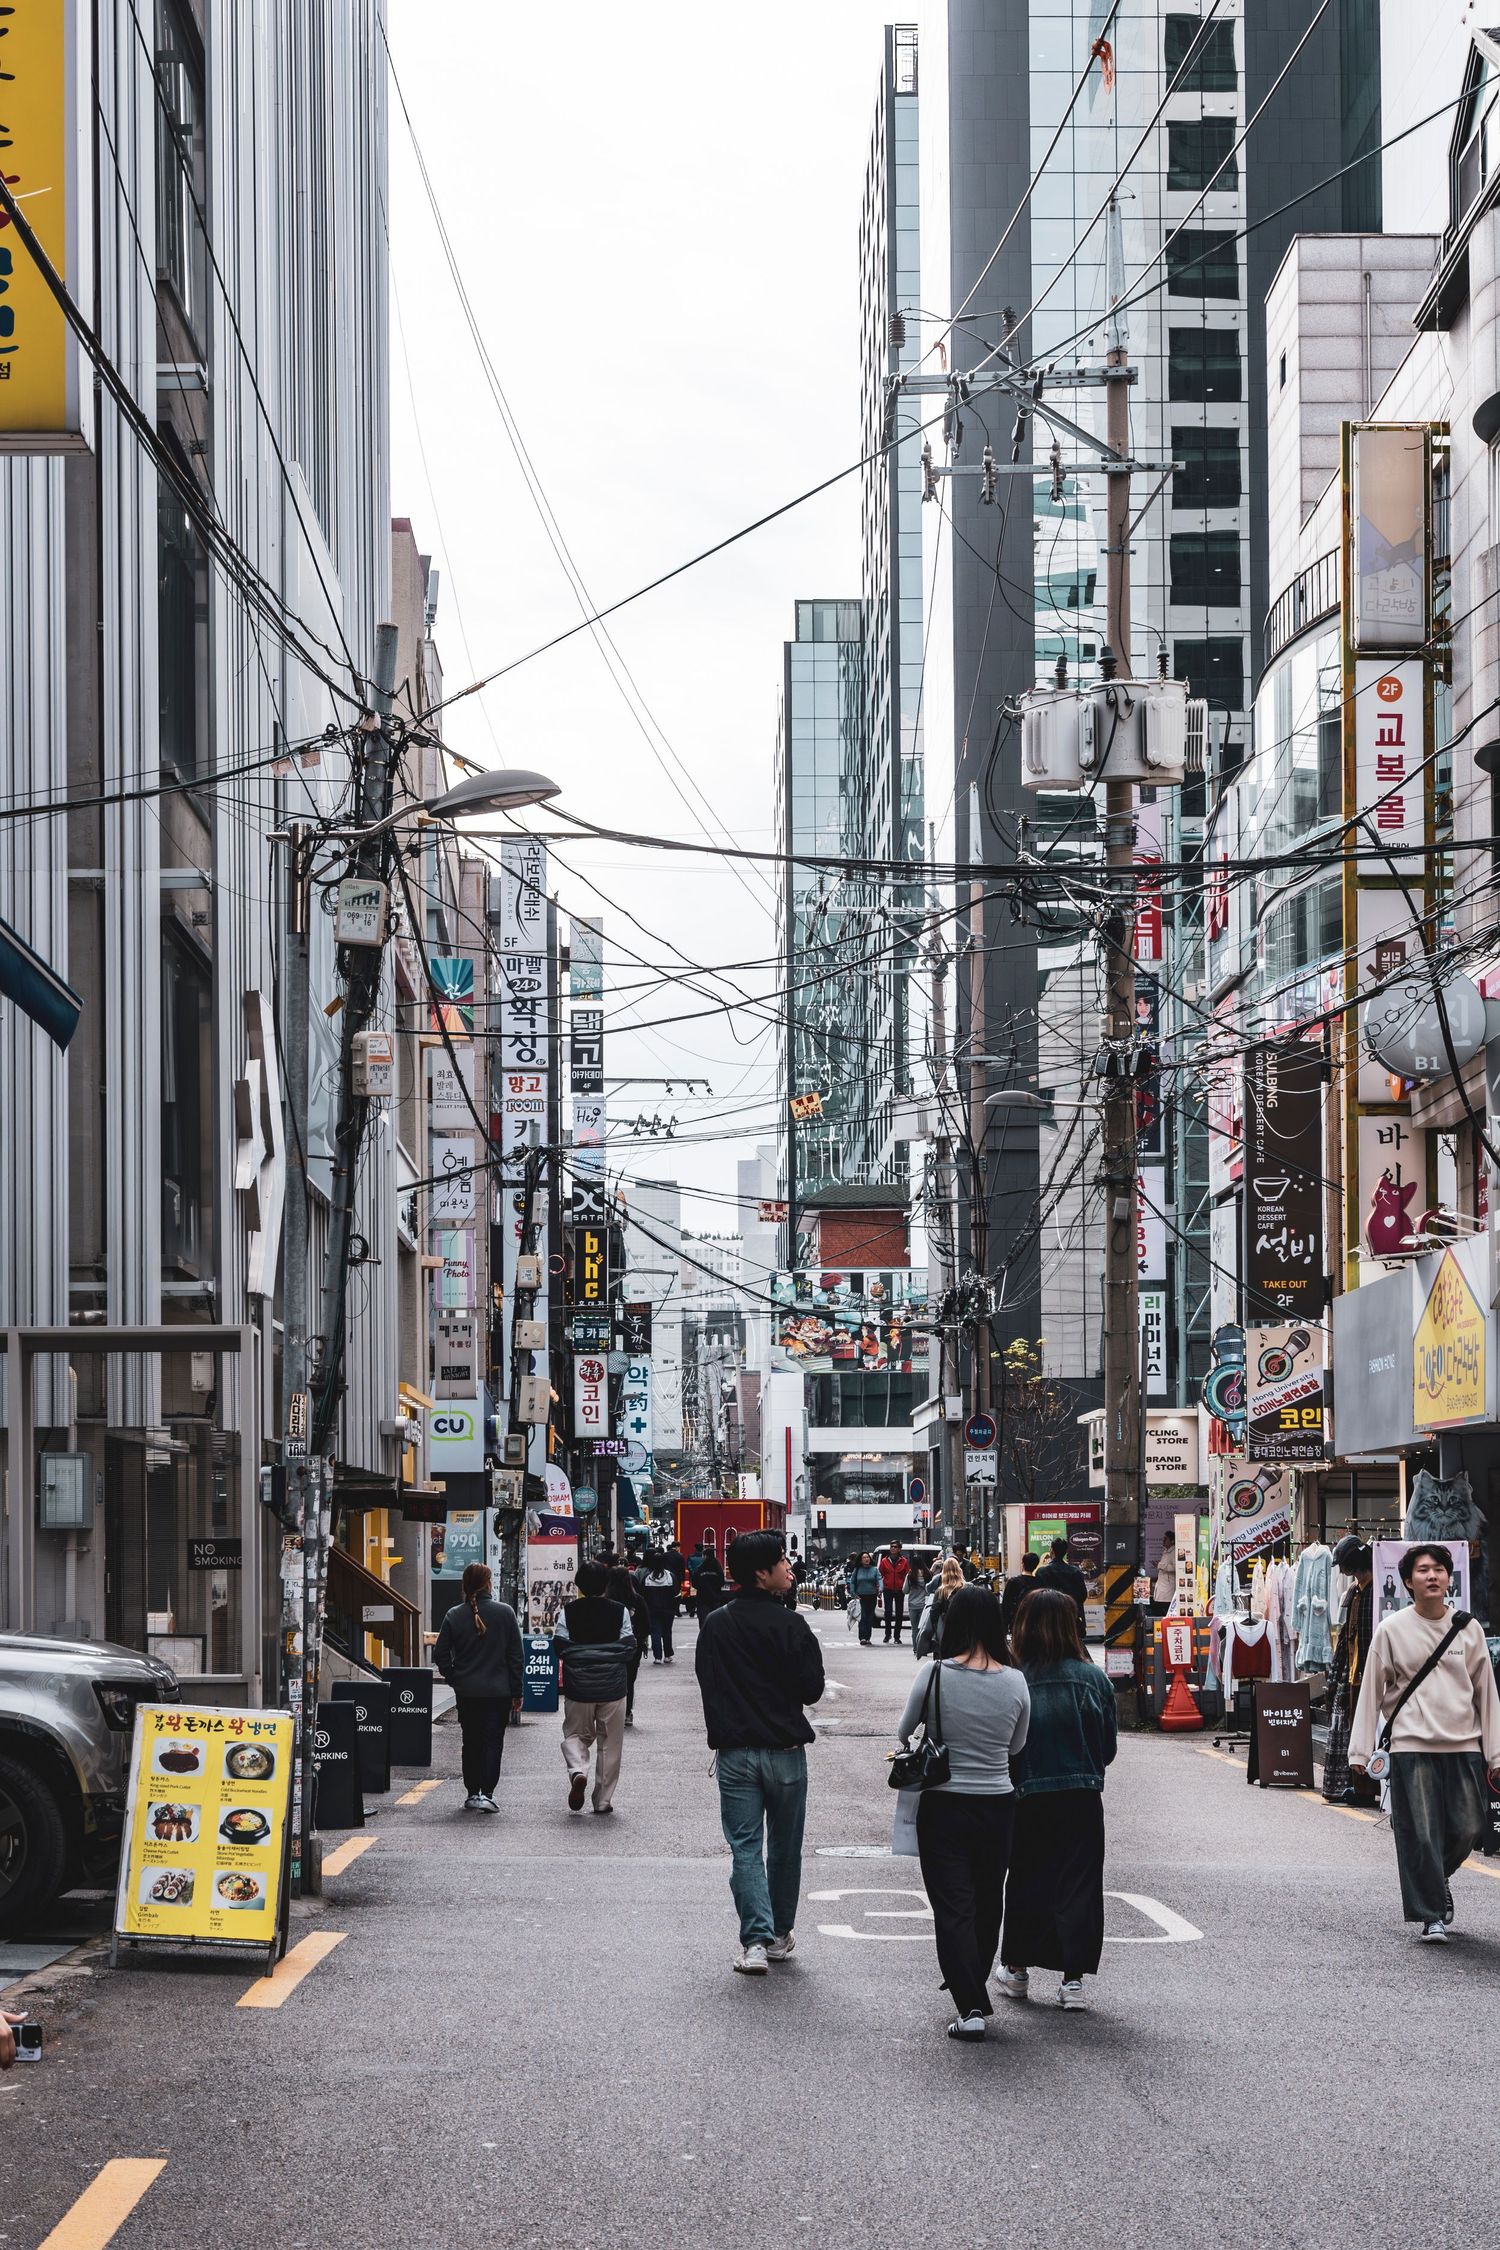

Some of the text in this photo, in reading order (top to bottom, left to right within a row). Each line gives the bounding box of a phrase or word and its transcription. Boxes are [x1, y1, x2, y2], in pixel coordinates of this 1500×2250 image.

[1381, 683, 1398, 696] 2F
[504, 937, 518, 948] 5F
[512, 980, 539, 991] 24시
[1415, 1056, 1441, 1070] B1
[1255, 1052, 1264, 1091] KOREAN
[508, 1076, 542, 1094] 망고
[437, 1091, 463, 1100] 스튜디
[506, 1099, 544, 1112] room
[1256, 1094, 1264, 1137] DESSERT
[1256, 1227, 1315, 1264] 설빙
[443, 1257, 469, 1269] Funny
[585, 1231, 599, 1298] bhc
[443, 1268, 471, 1278] Photo
[1263, 1280, 1308, 1288] TAKE OUT
[1276, 1294, 1294, 1306] 2F
[628, 1366, 648, 1387] 약
[1274, 1372, 1315, 1393] University
[582, 1385, 600, 1424] 코인
[1252, 1379, 1320, 1416] COIN노래연습장
[1279, 1407, 1322, 1429] 코인
[434, 1418, 465, 1434] CU
[967, 1454, 995, 1462] 견인지역
[1246, 1511, 1286, 1536] University
[449, 1534, 477, 1548] 990
[1225, 1519, 1290, 1561] OIN노래연습장
[194, 1543, 216, 1555] NO
[1173, 1628, 1184, 1662] 주차금지
[529, 1655, 550, 1665] 24H
[525, 1665, 553, 1675] OPEN
[228, 1716, 277, 1736] 왕냉면
[1281, 1749, 1290, 1757] B1
